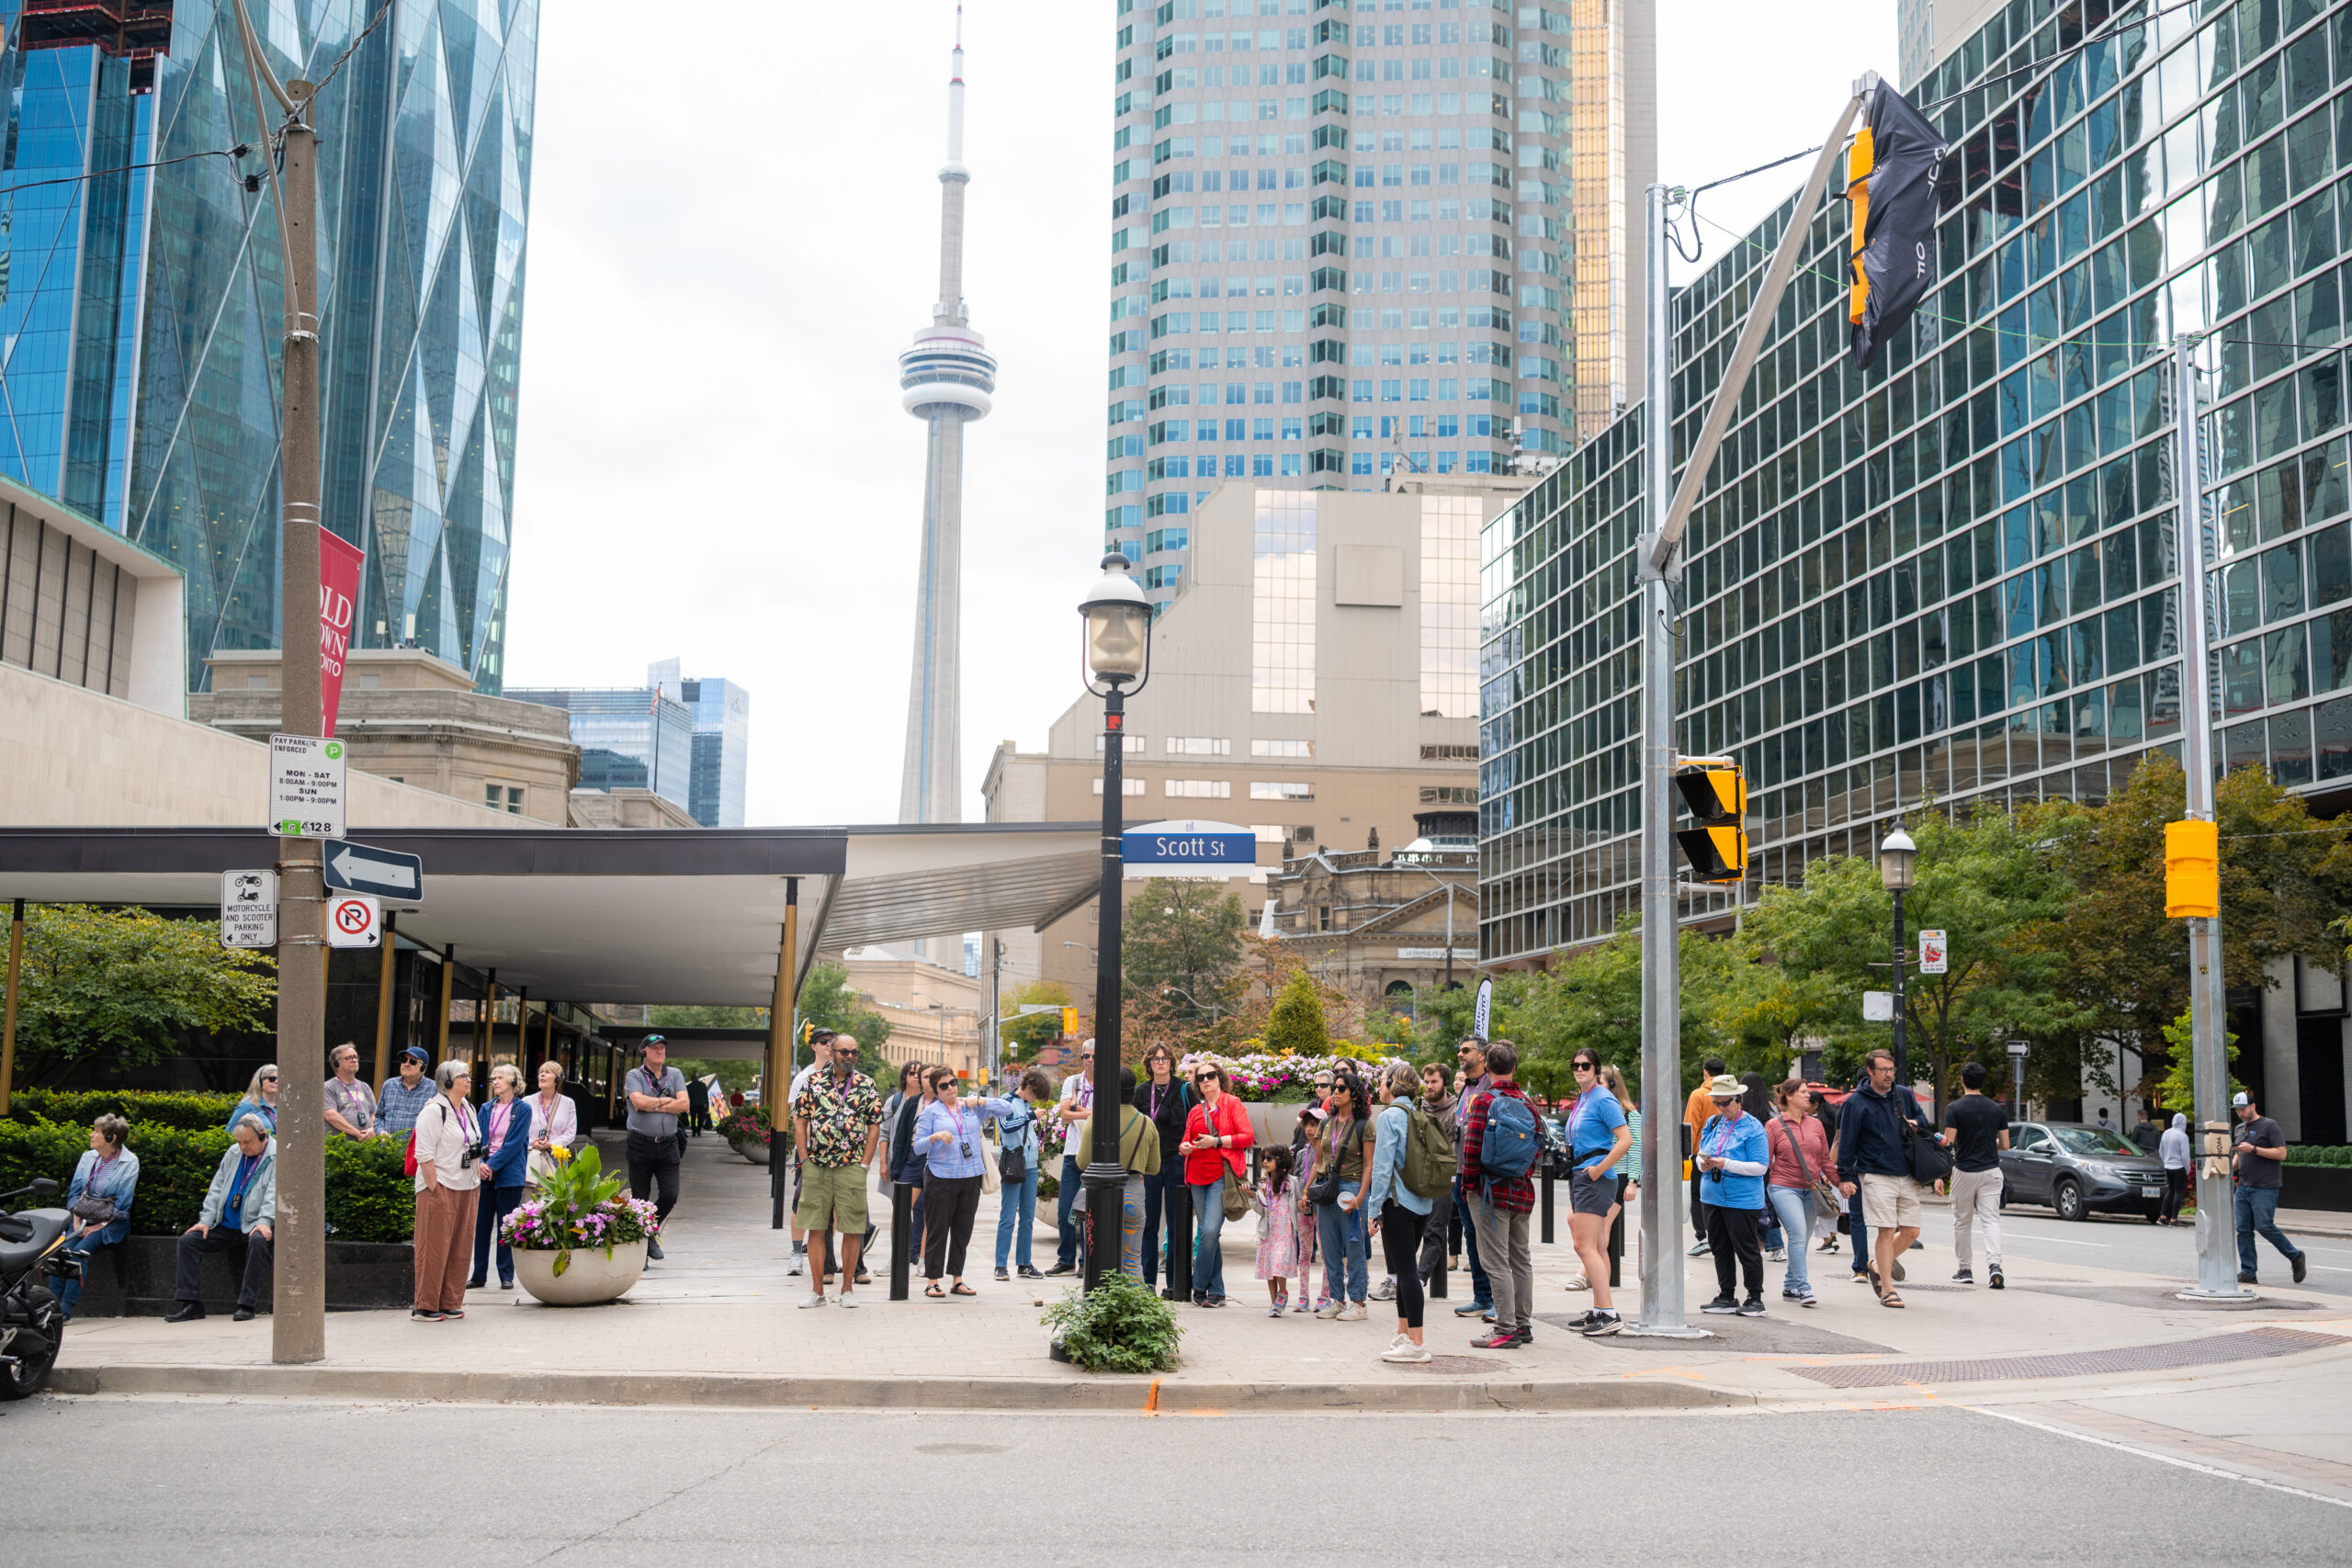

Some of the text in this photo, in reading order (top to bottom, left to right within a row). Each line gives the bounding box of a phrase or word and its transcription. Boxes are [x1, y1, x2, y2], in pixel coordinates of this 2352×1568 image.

[288, 739, 317, 748] PARKG
[274, 746, 307, 754] ENFORCED
[278, 778, 305, 786] 8:00AM
[1156, 837, 1226, 857] Scott St
[227, 904, 271, 912] MOTORCYCLE
[225, 913, 273, 922] AND SCOOTER
[234, 923, 265, 931] PARKING
[240, 932, 258, 941] ONLY
